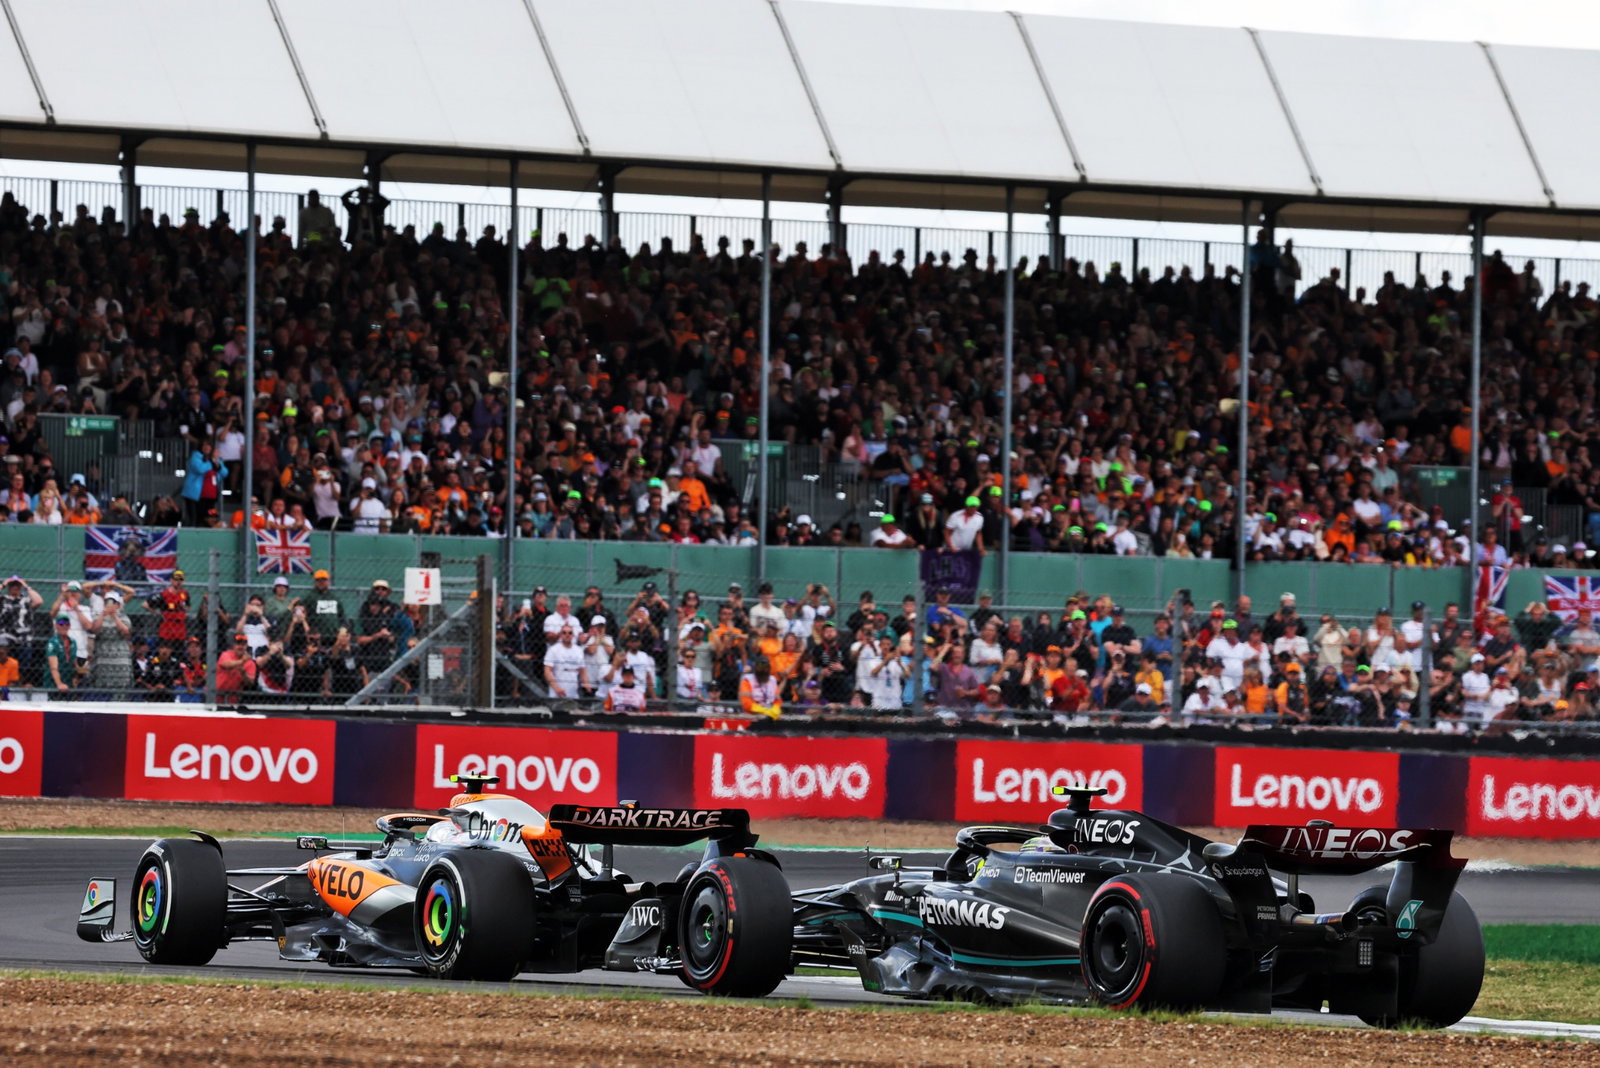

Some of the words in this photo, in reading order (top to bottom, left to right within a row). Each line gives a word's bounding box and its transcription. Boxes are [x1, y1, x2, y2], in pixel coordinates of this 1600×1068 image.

[144, 732, 319, 784] Lenovo
[433, 744, 600, 794] Lenovo
[711, 753, 870, 800] Lenovo
[1231, 763, 1383, 812] Lenovo
[571, 807, 722, 829] DARKTRACE
[1073, 818, 1141, 845] INEOS
[1279, 827, 1414, 860] INEOS
[319, 862, 364, 900] VELO
[1025, 868, 1085, 884] TeamViewer
[630, 906, 660, 926] IWC
[918, 896, 1010, 930] PETRONAS
